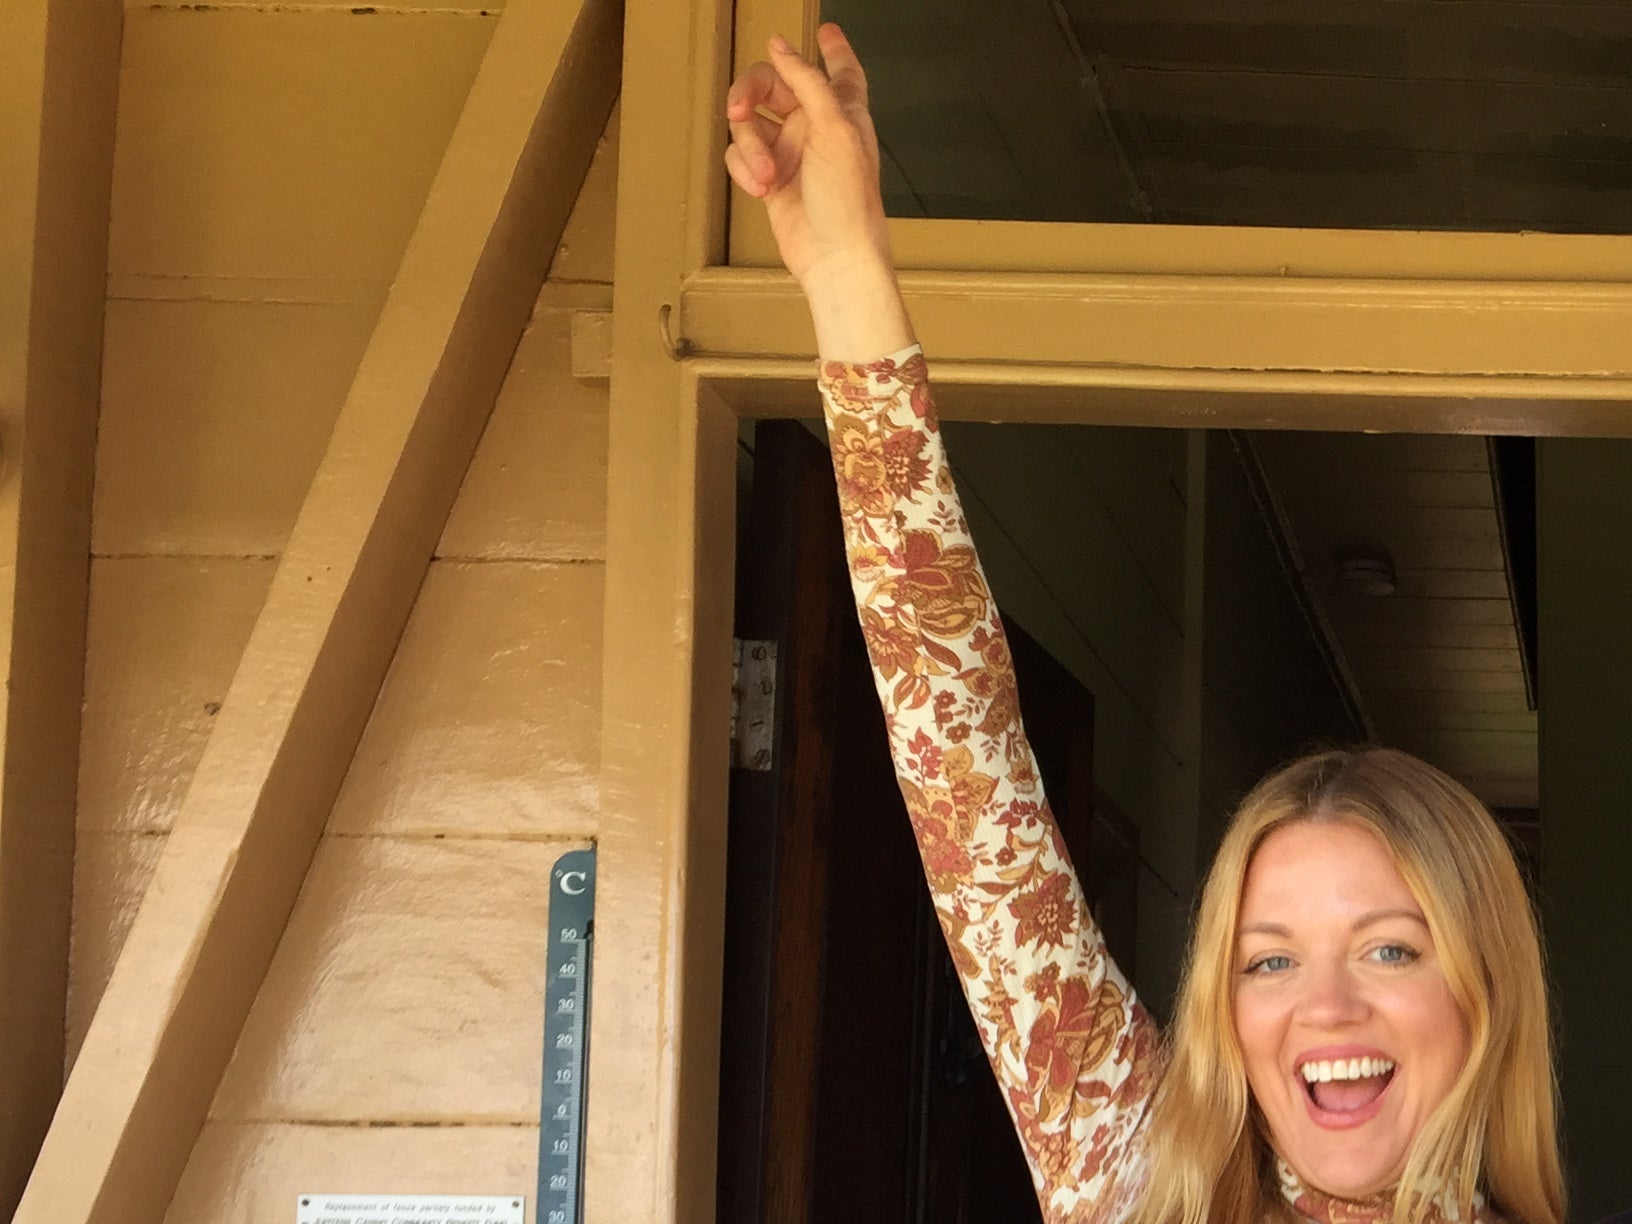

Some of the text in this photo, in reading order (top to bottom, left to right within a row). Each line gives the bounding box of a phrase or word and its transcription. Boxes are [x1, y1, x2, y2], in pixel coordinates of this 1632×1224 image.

[561, 928, 578, 939] 50
[559, 963, 576, 975] 40
[558, 998, 575, 1010] 30
[556, 1033, 573, 1045] 20
[556, 1069, 572, 1081] 10
[557, 1104, 567, 1117] 0
[553, 1139, 568, 1151] 10
[551, 1174, 567, 1187] 20
[548, 1210, 565, 1222] 30
